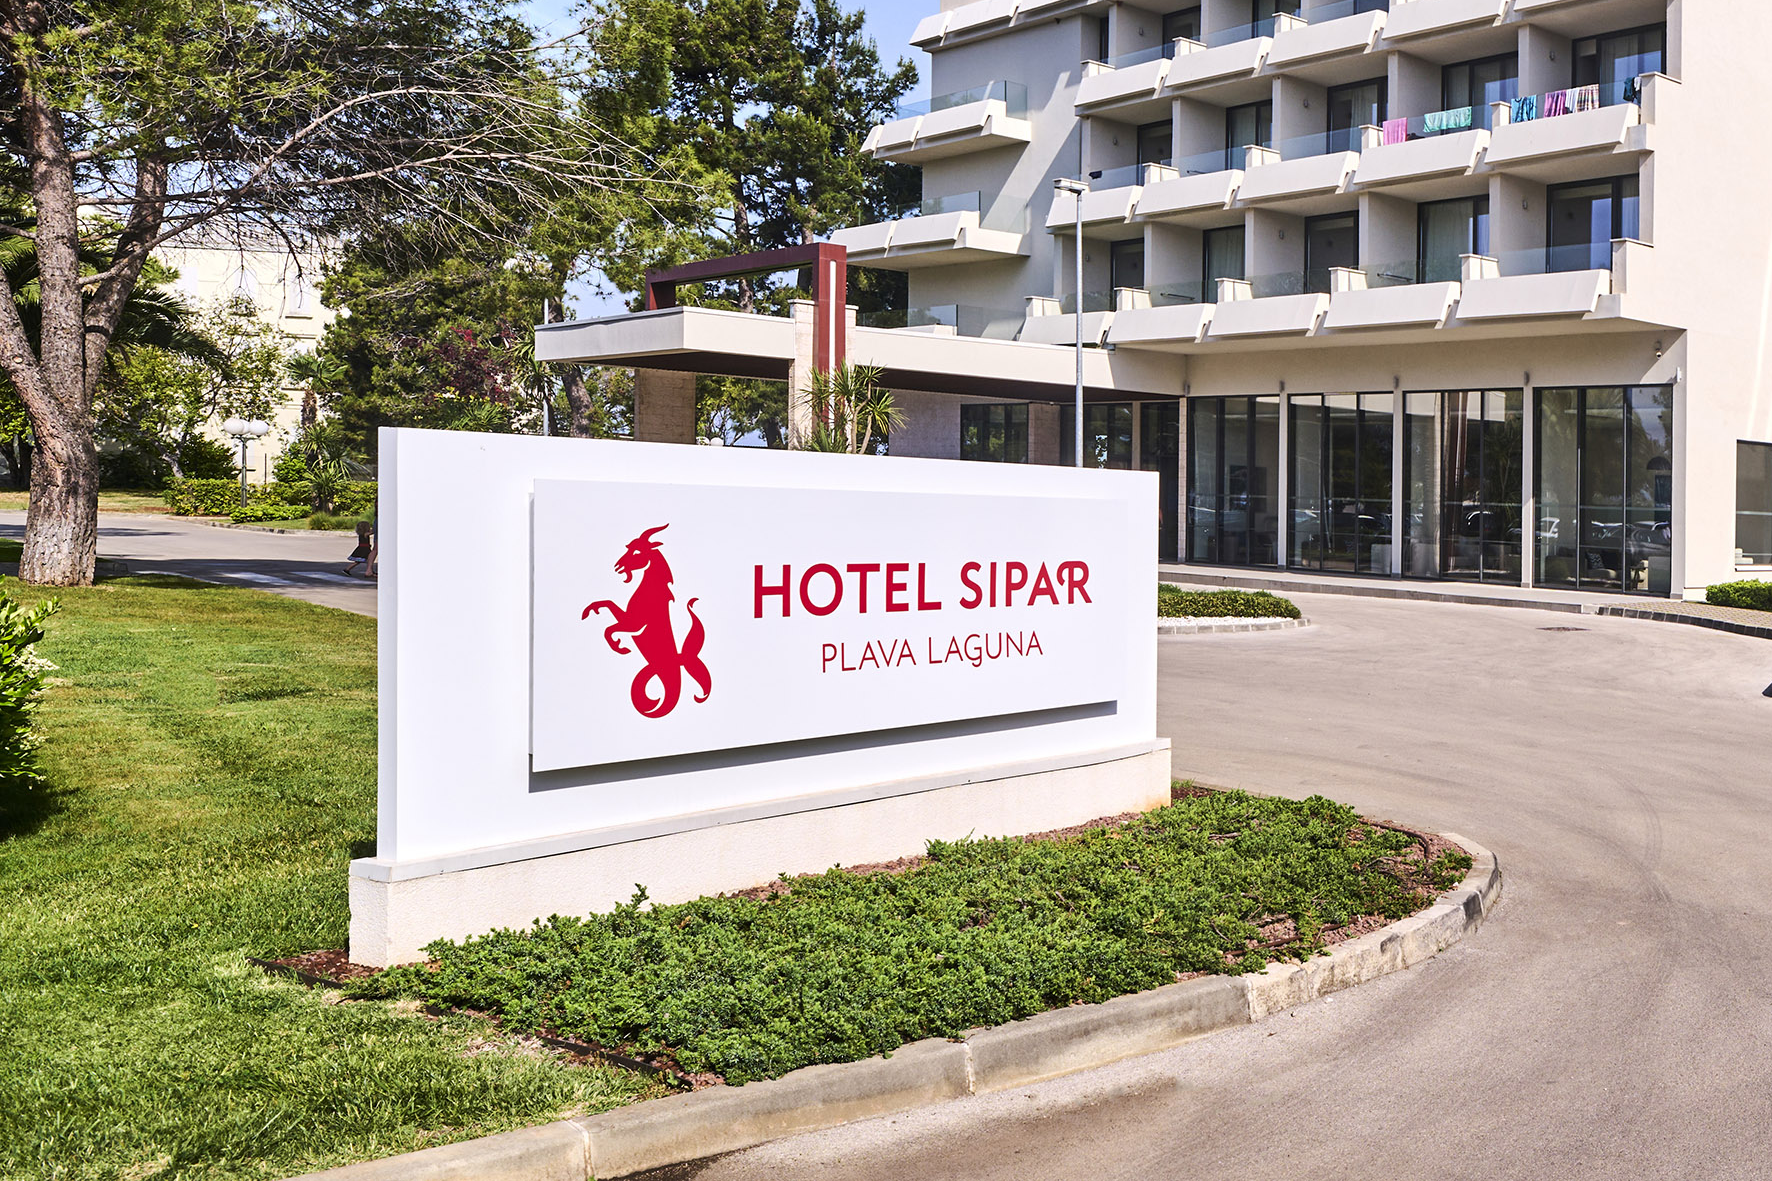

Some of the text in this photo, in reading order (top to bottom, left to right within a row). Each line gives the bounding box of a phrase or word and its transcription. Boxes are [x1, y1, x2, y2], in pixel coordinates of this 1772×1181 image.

[754, 560, 1093, 618] HOTEL SIPAR
[822, 630, 1044, 673] PLAVA LAGUNA
